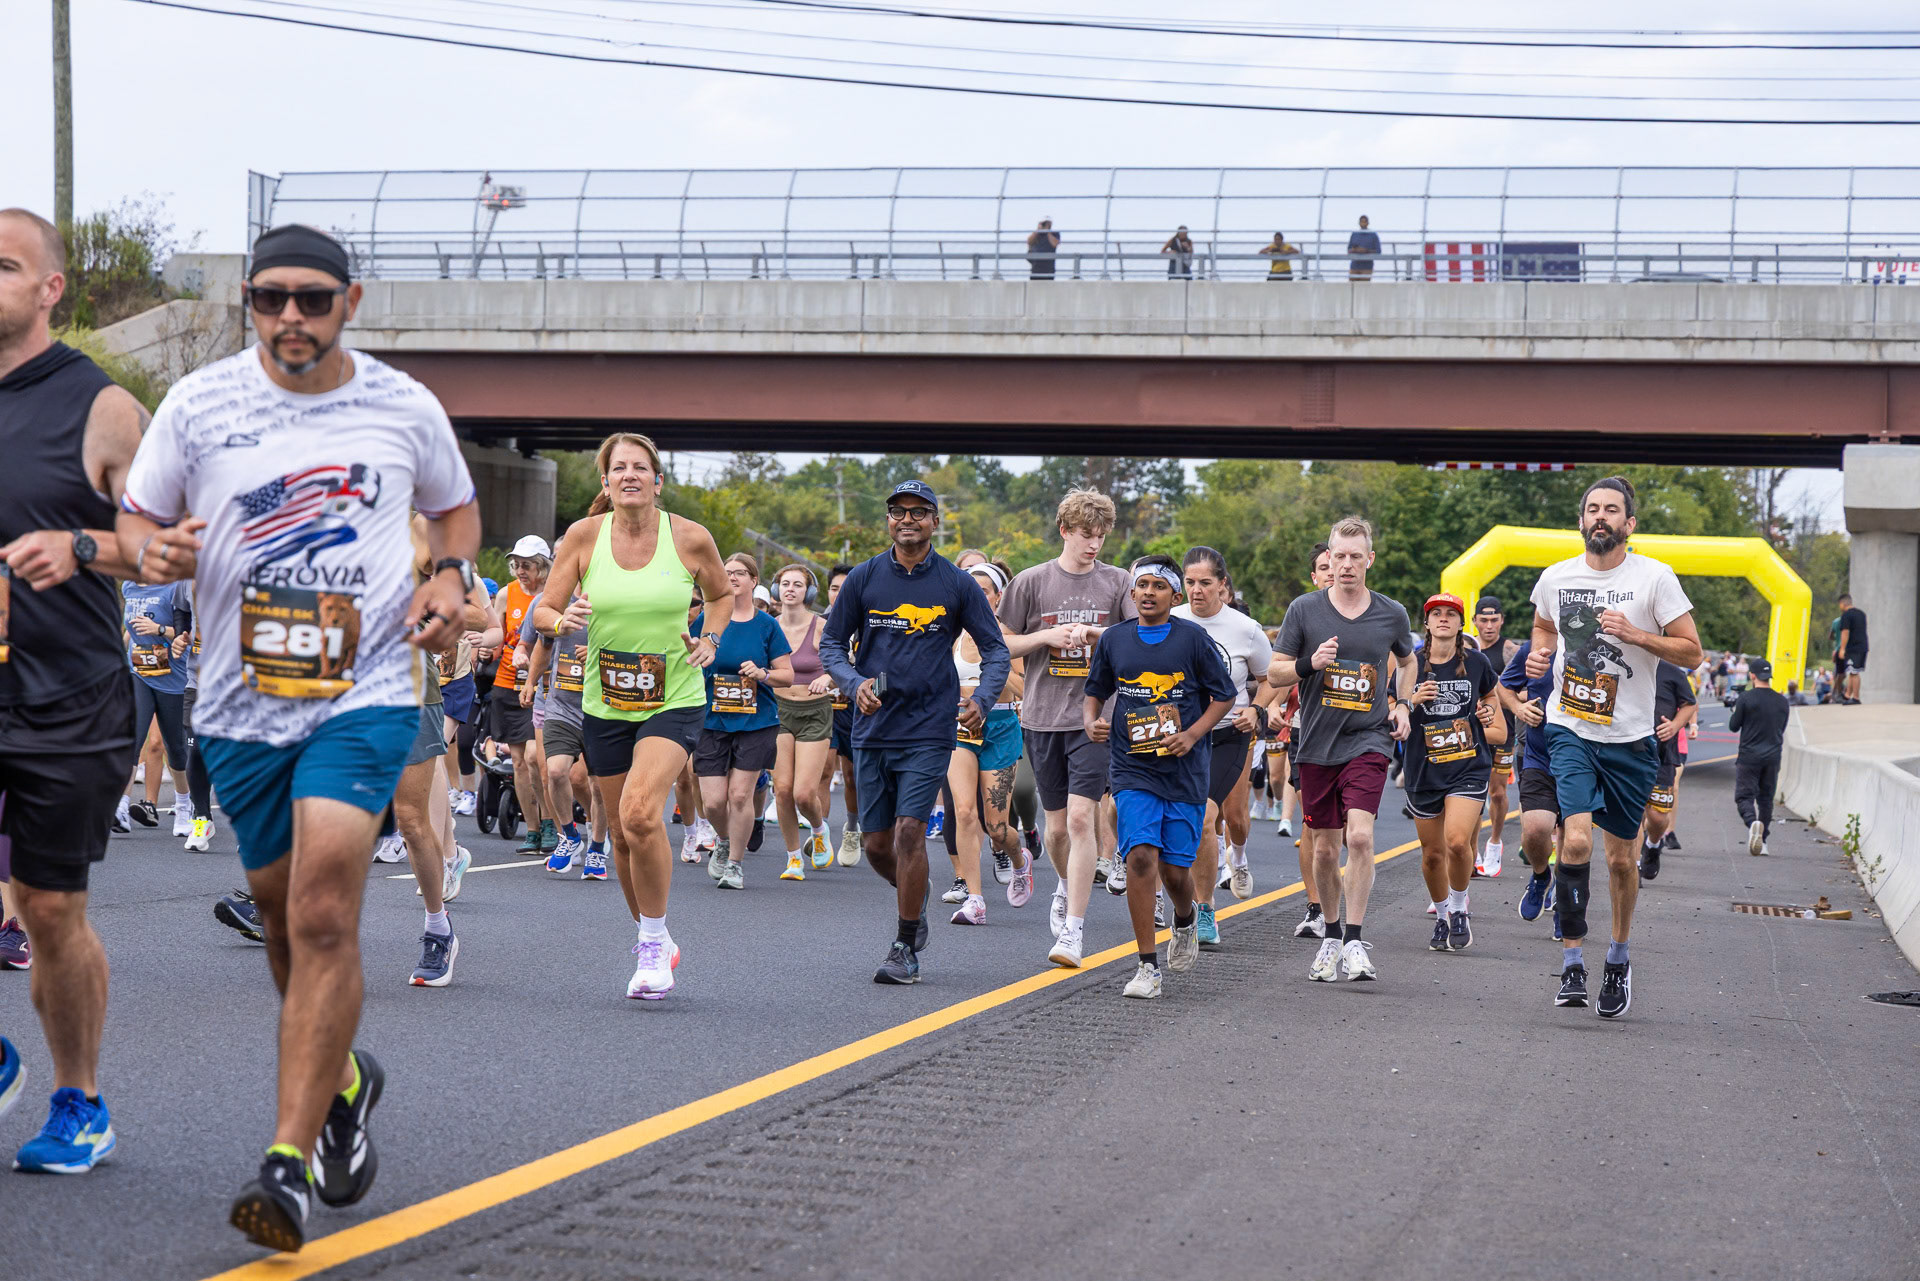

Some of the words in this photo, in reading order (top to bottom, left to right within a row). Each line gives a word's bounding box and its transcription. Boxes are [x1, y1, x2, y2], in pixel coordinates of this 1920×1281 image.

[1559, 590, 1594, 606] Attack
[1595, 594, 1605, 603] on
[1607, 590, 1634, 604] Titan
[242, 603, 291, 618] CHASE
[292, 608, 315, 620] 5K
[252, 620, 344, 658] 281
[140, 654, 158, 665] 13
[600, 660, 626, 669] CHASE
[570, 664, 582, 677] 8
[1325, 667, 1349, 675] CHASE
[1566, 665, 1577, 674] THE
[606, 669, 655, 690] 138
[1331, 675, 1370, 692] 160
[1564, 672, 1583, 683] CHASE
[1583, 678, 1594, 686] 5K
[716, 686, 753, 699] 323
[1567, 680, 1608, 704] 163
[1127, 717, 1147, 725] CHASE
[1131, 719, 1177, 742] 274
[1431, 731, 1467, 748] 341
[1650, 792, 1674, 803] 330
